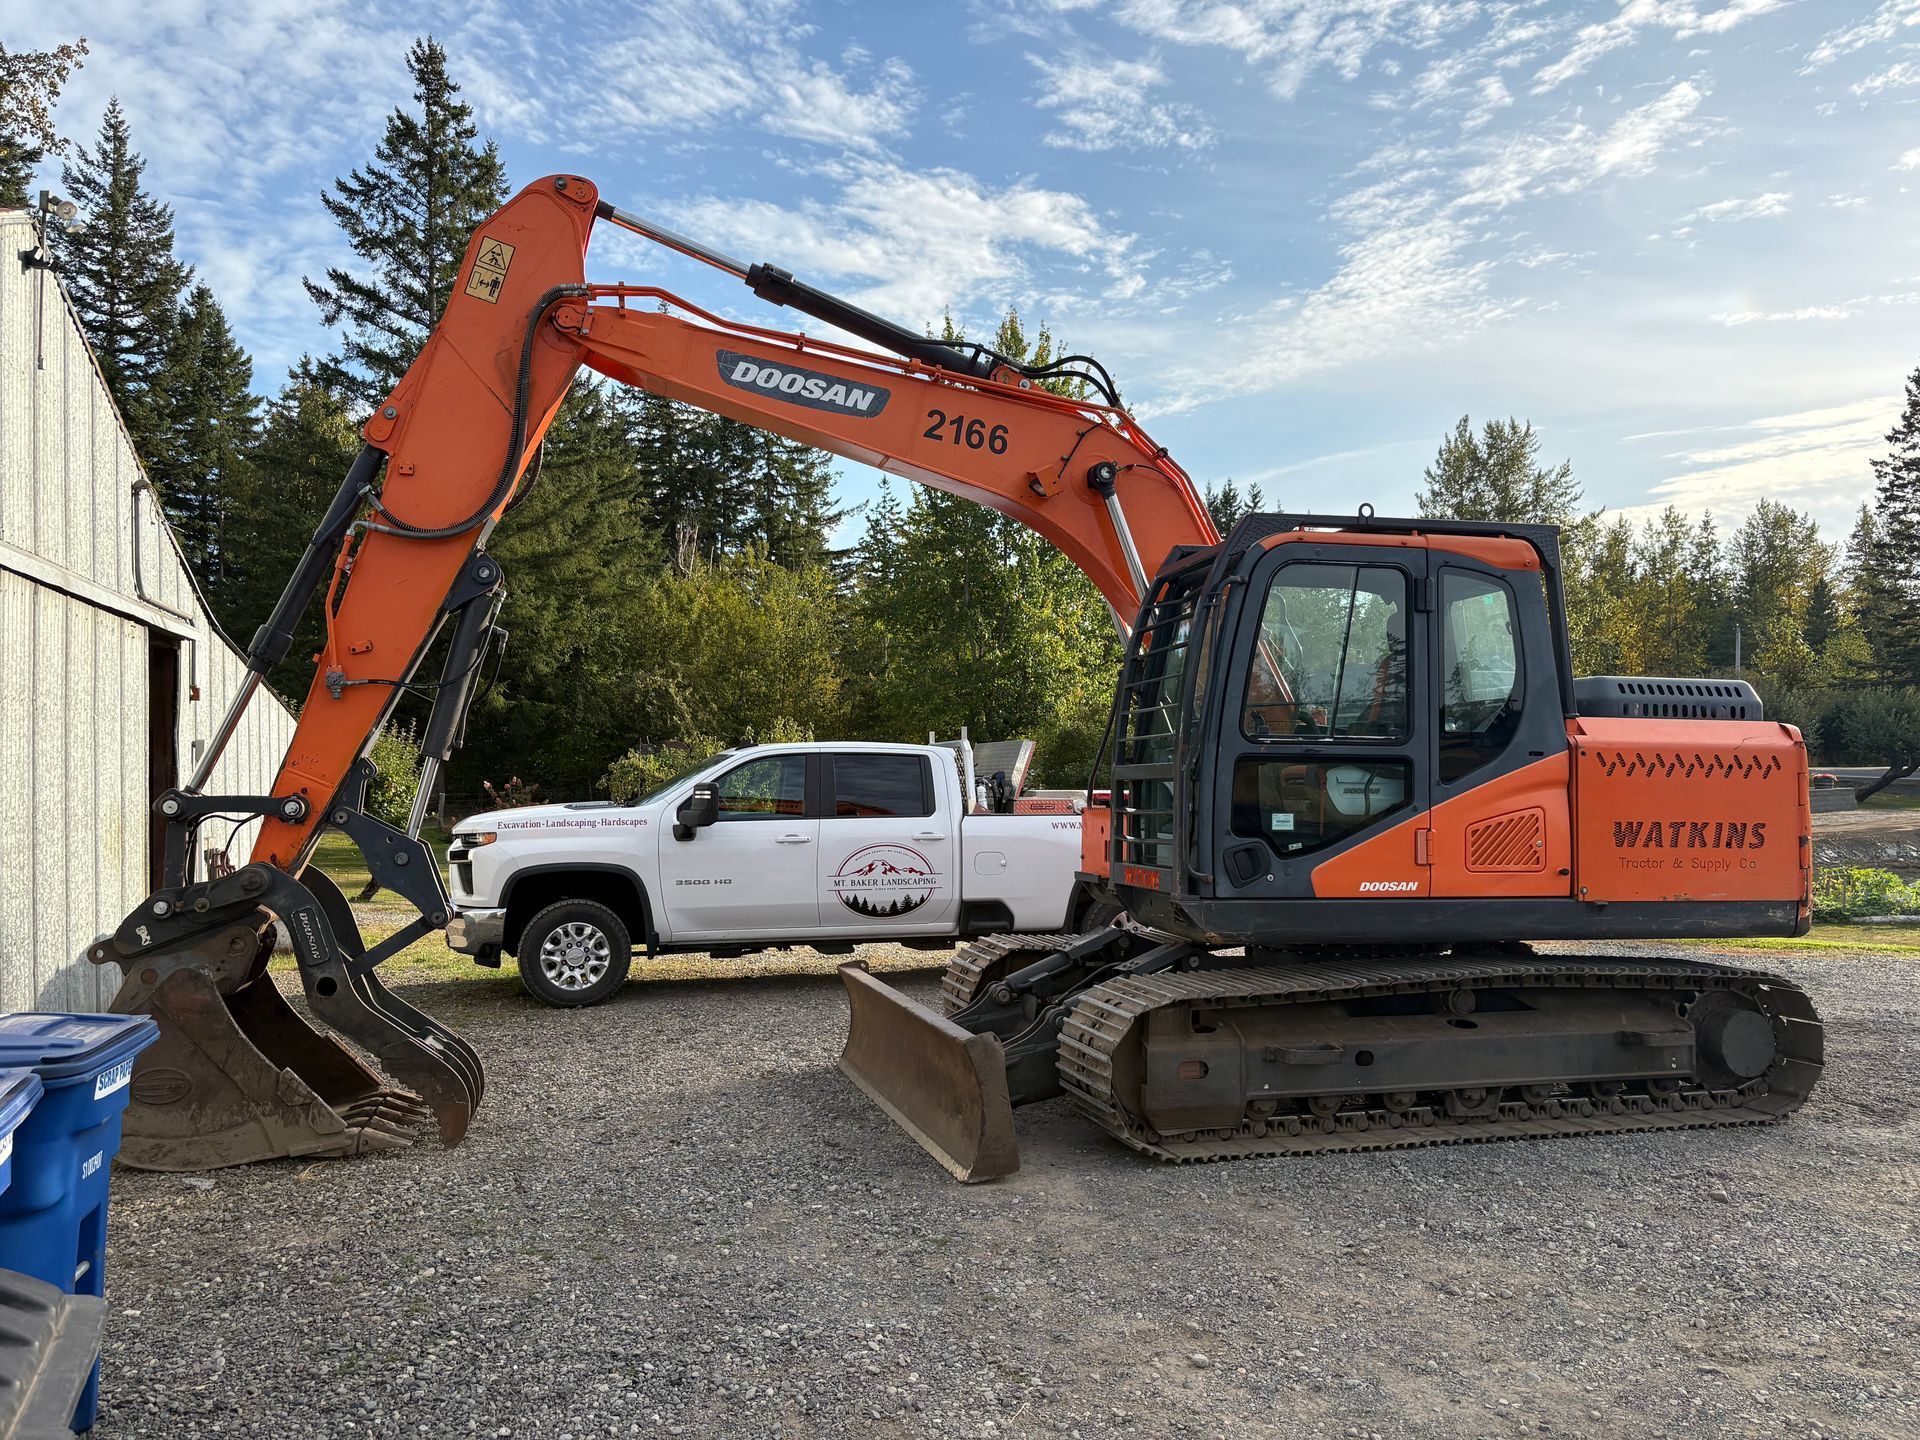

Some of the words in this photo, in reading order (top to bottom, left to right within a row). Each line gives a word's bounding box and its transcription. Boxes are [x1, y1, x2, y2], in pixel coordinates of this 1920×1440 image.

[731, 361, 875, 411] DOOSAN
[923, 409, 1009, 455] 2166
[1613, 821, 1766, 849] WATKINS
[1619, 857, 1665, 869] Tractor
[1672, 857, 1683, 869] &
[1691, 857, 1731, 871] Supply
[1739, 857, 1757, 869] Co
[850, 879, 878, 887] BAKER
[881, 877, 937, 886] LANDSCAPING
[1359, 881, 1419, 892] DOOSAN
[299, 912, 321, 959] DOOSAN
[98, 1066, 119, 1091] SCRAP
